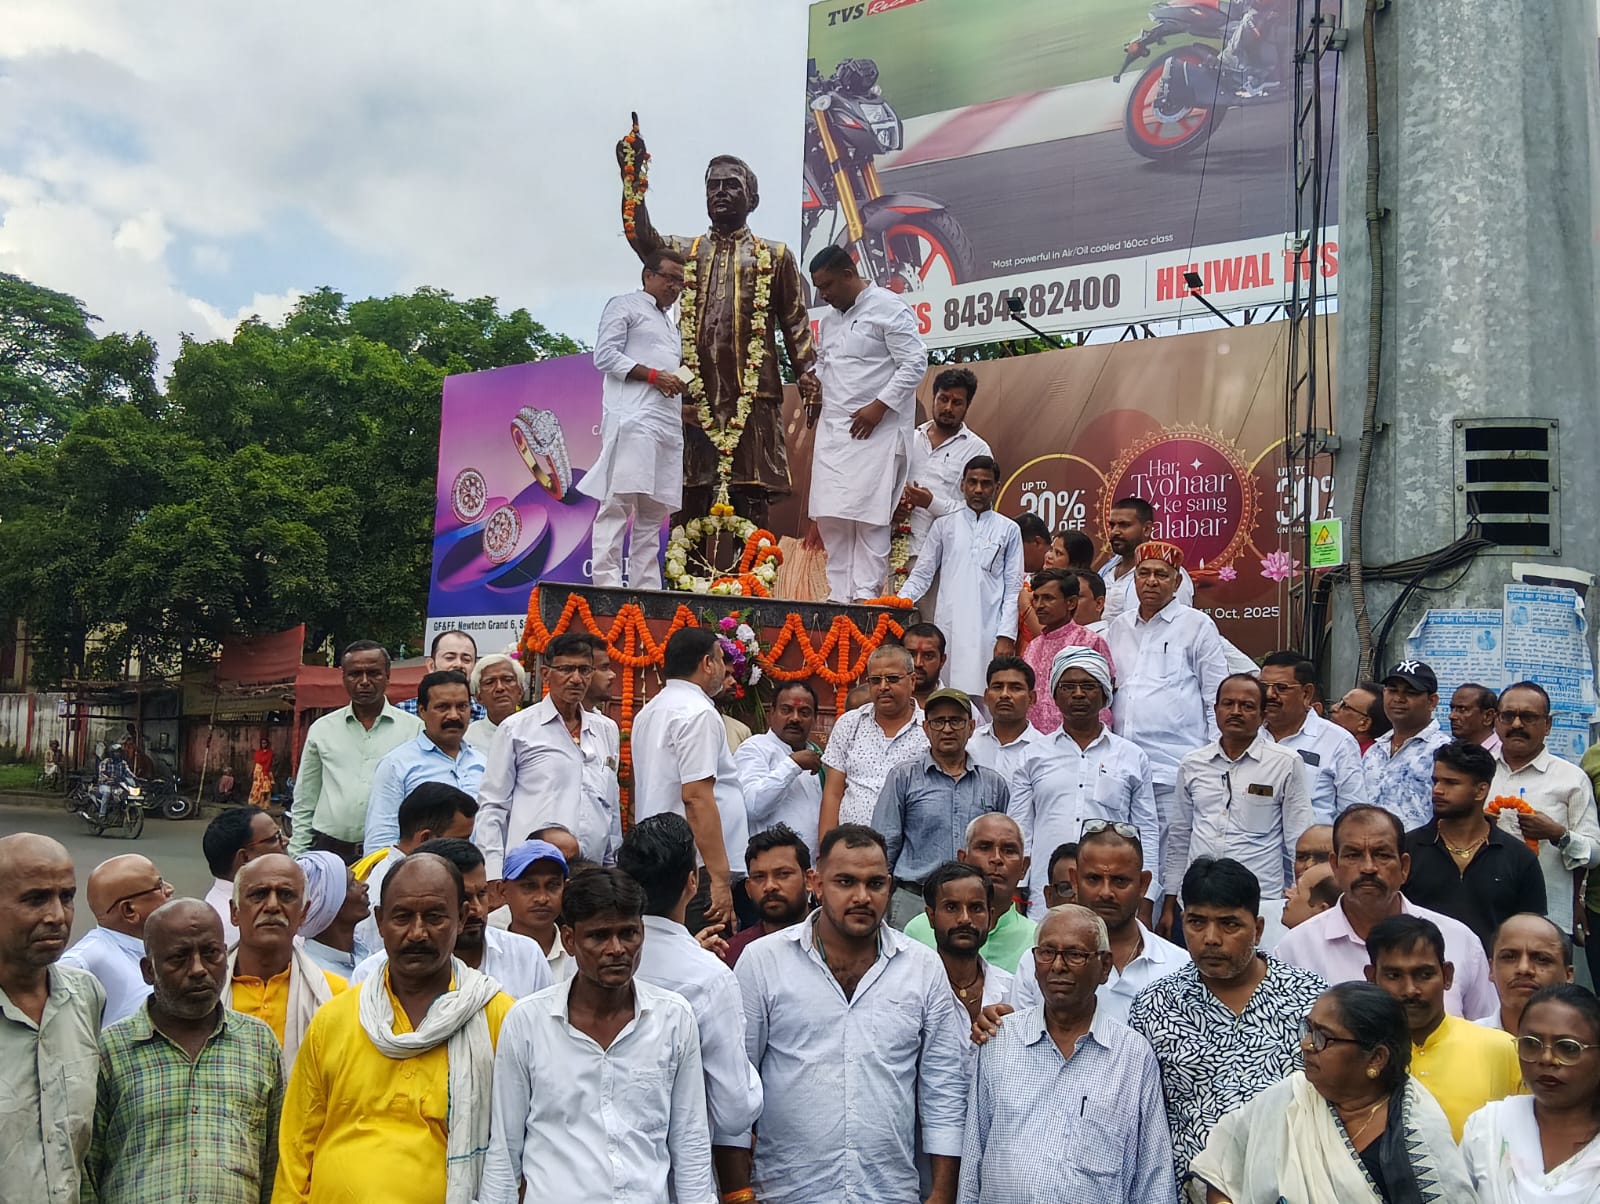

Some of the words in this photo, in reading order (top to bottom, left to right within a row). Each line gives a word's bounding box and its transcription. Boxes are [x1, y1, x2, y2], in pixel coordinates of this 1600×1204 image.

[828, 3, 865, 26] TVS
[1014, 250, 1050, 266] powerful
[1052, 250, 1060, 260] in
[1061, 245, 1089, 258] Air/Oil
[1090, 240, 1120, 253] cooled
[1122, 238, 1149, 249] 160cc
[1150, 233, 1174, 245] class
[1149, 458, 1180, 477] Har
[1021, 481, 1034, 491] UP
[1036, 480, 1047, 490] TO
[1129, 470, 1233, 505] Tyohaar
[1163, 496, 1182, 514] ke
[1186, 496, 1227, 513] sang
[1150, 513, 1228, 540] alabar
[1214, 607, 1240, 620] Oct,
[1243, 606, 1280, 619] 2025
[458, 620, 487, 631] Newtech
[488, 619, 509, 630] Grand
